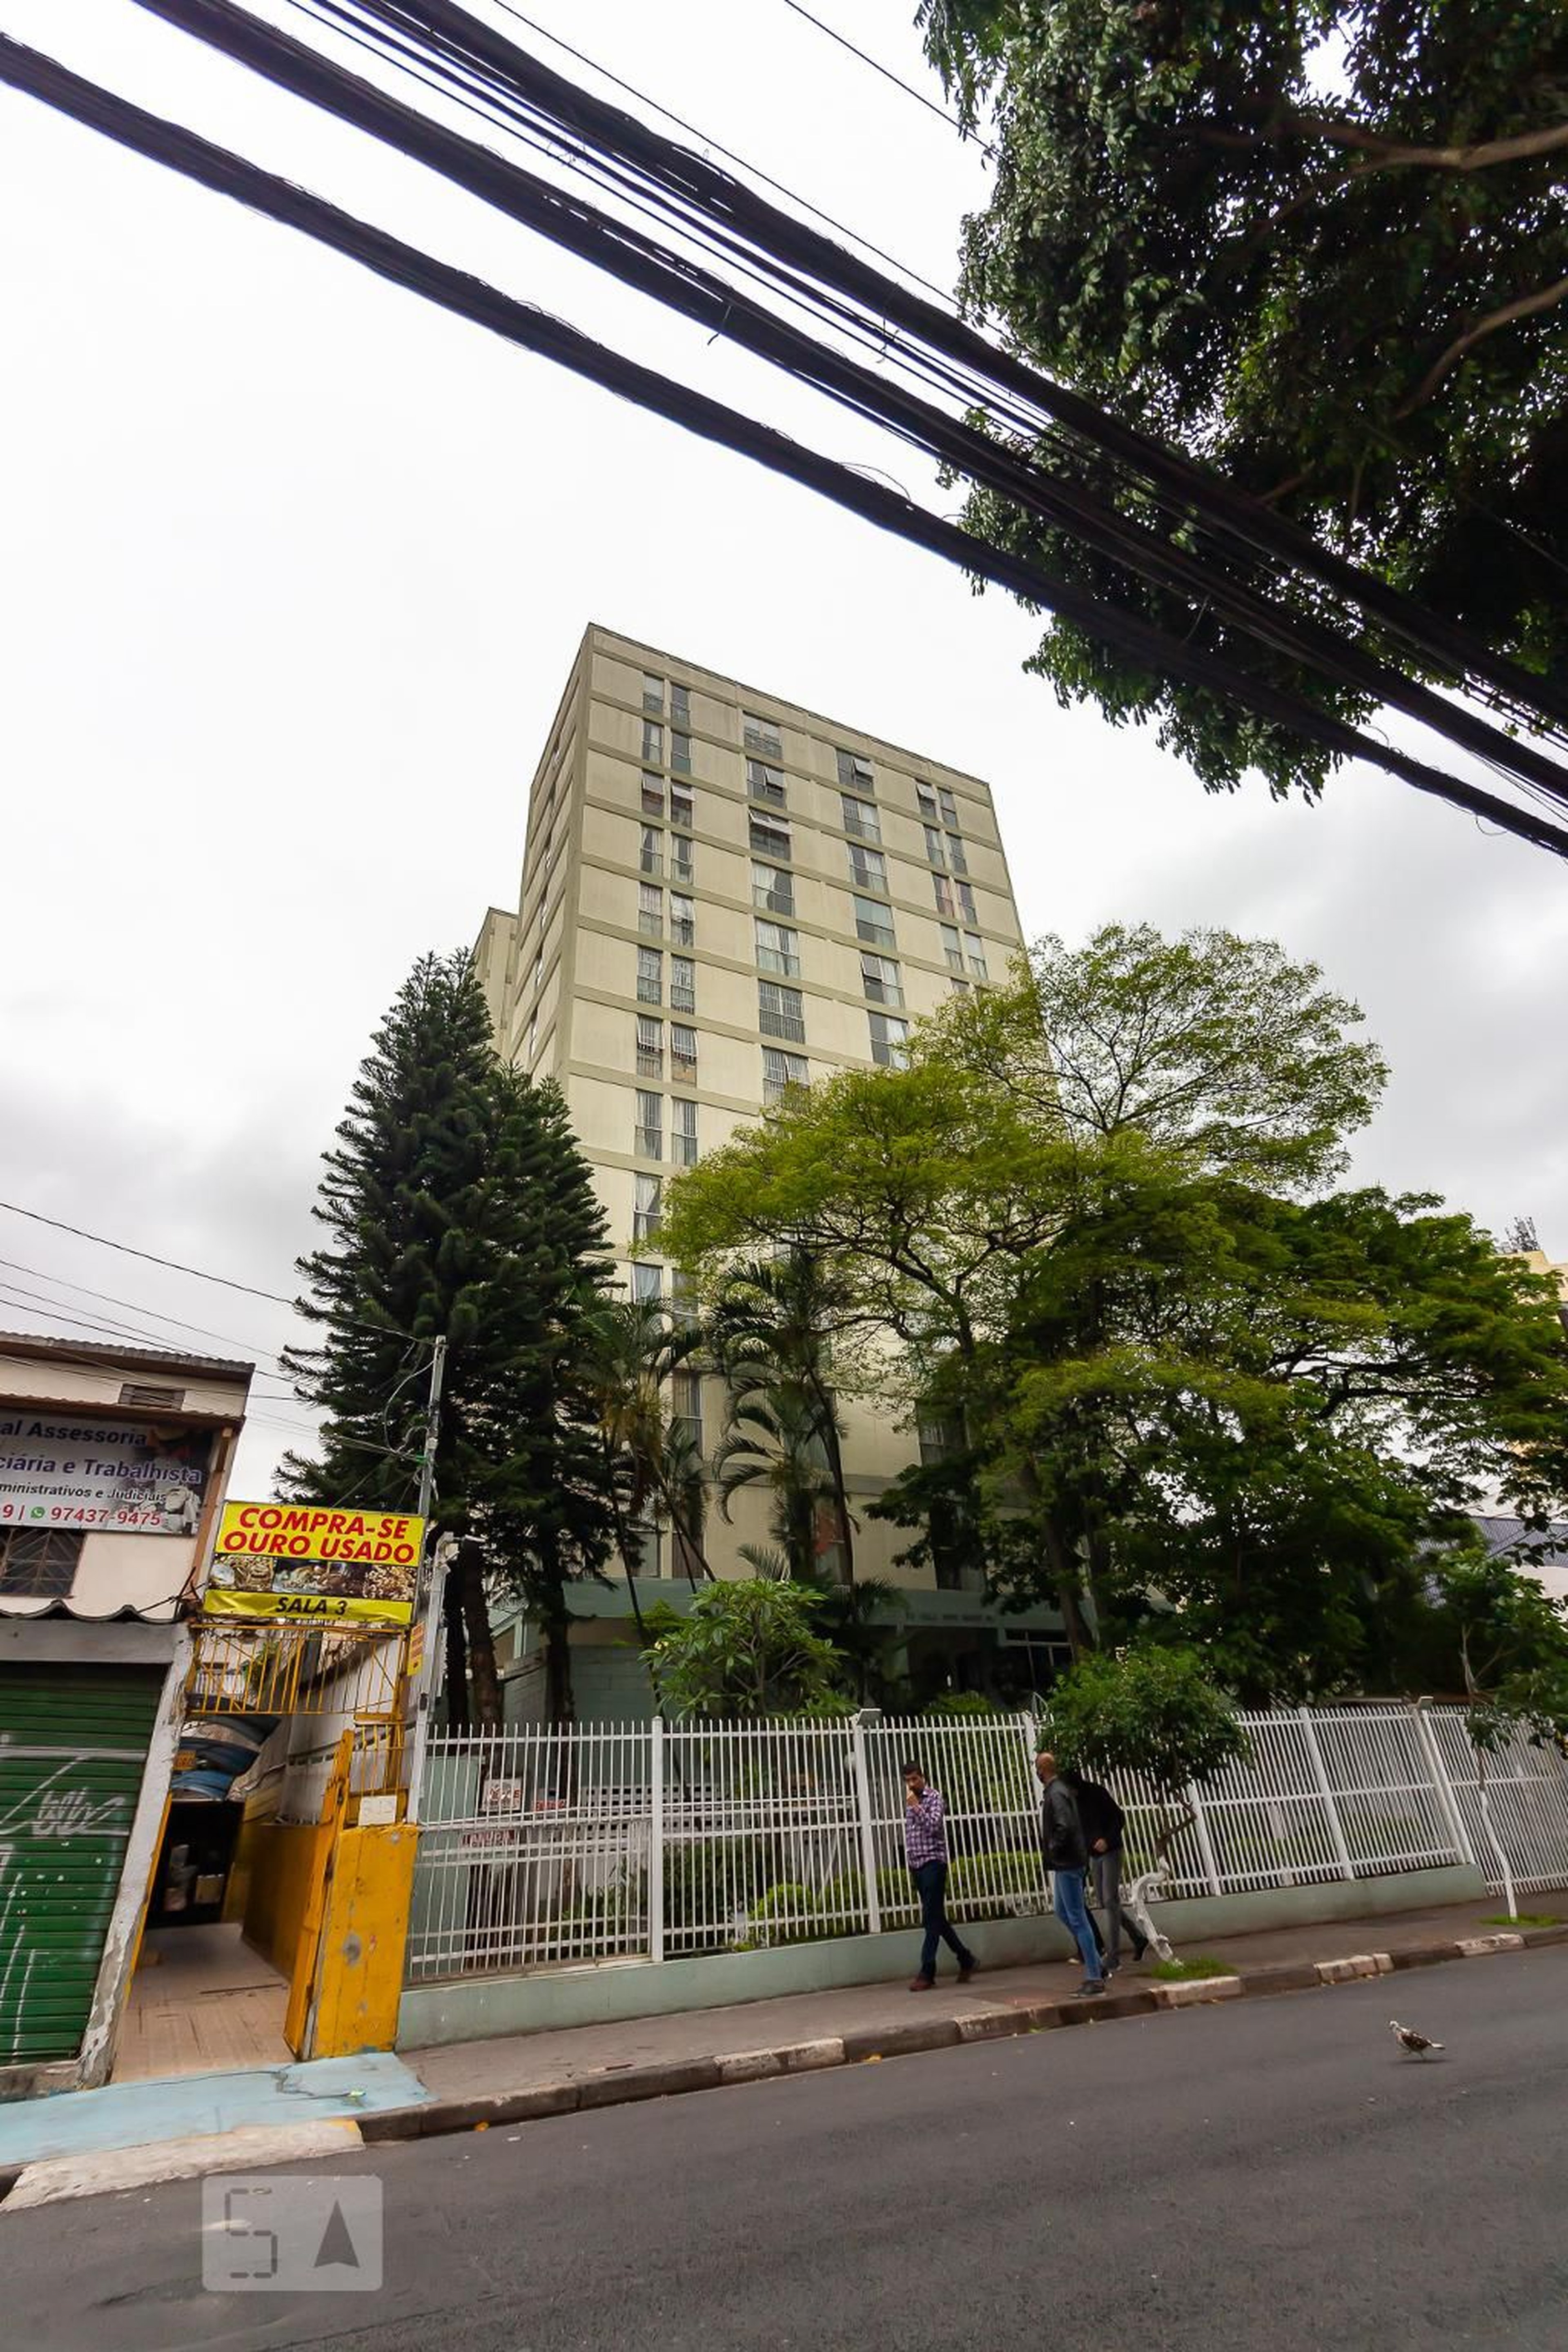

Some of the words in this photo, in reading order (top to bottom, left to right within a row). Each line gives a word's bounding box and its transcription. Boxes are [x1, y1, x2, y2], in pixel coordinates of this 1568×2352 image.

[27, 1421, 147, 1446] Assessoria
[62, 1461, 76, 1473] e
[84, 1459, 200, 1483] Trabalhista
[107, 1488, 166, 1502] Judiciais
[51, 1507, 160, 1526] 97437-9475
[240, 1508, 409, 1539] COMPRA-SE
[224, 1531, 310, 1555] OURO
[320, 1538, 414, 1564] USADO
[275, 1597, 327, 1614] SALA
[335, 1600, 347, 1615] 3
